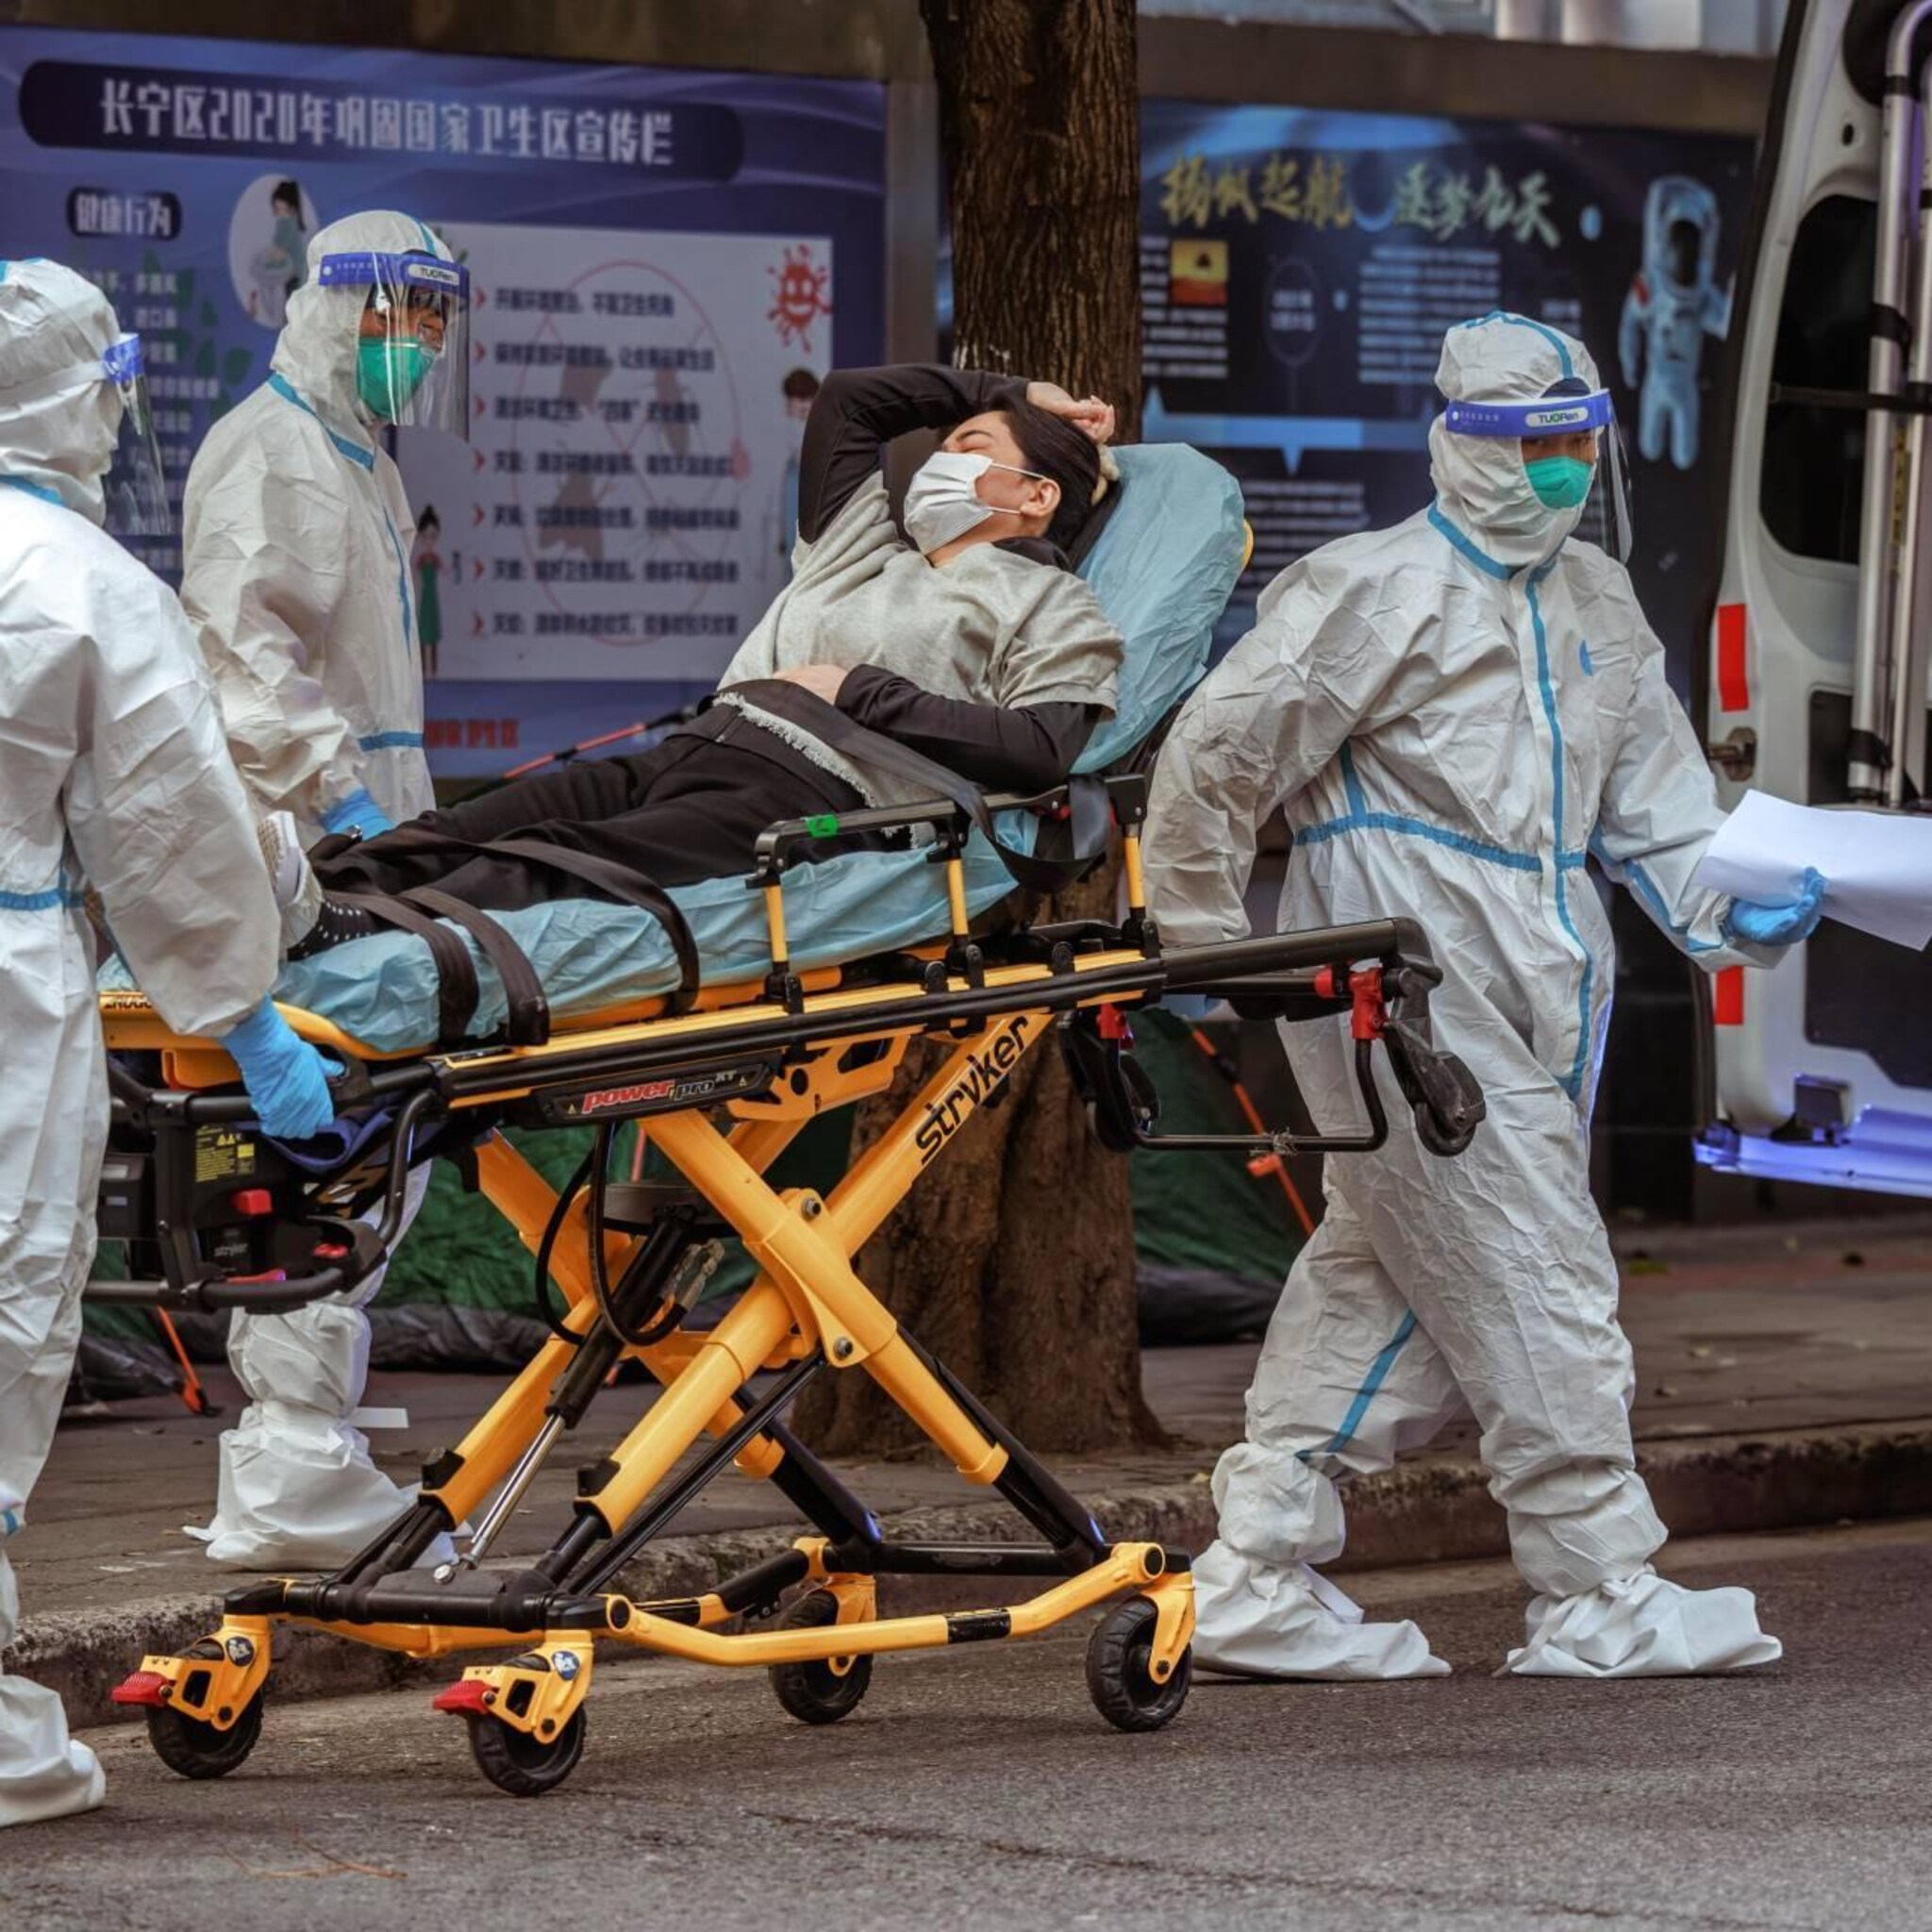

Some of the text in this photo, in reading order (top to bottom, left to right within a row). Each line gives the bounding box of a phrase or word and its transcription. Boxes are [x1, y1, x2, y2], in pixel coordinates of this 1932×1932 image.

[100, 78, 673, 165] 长宁区2020年巩固国家卫生区宣传栏
